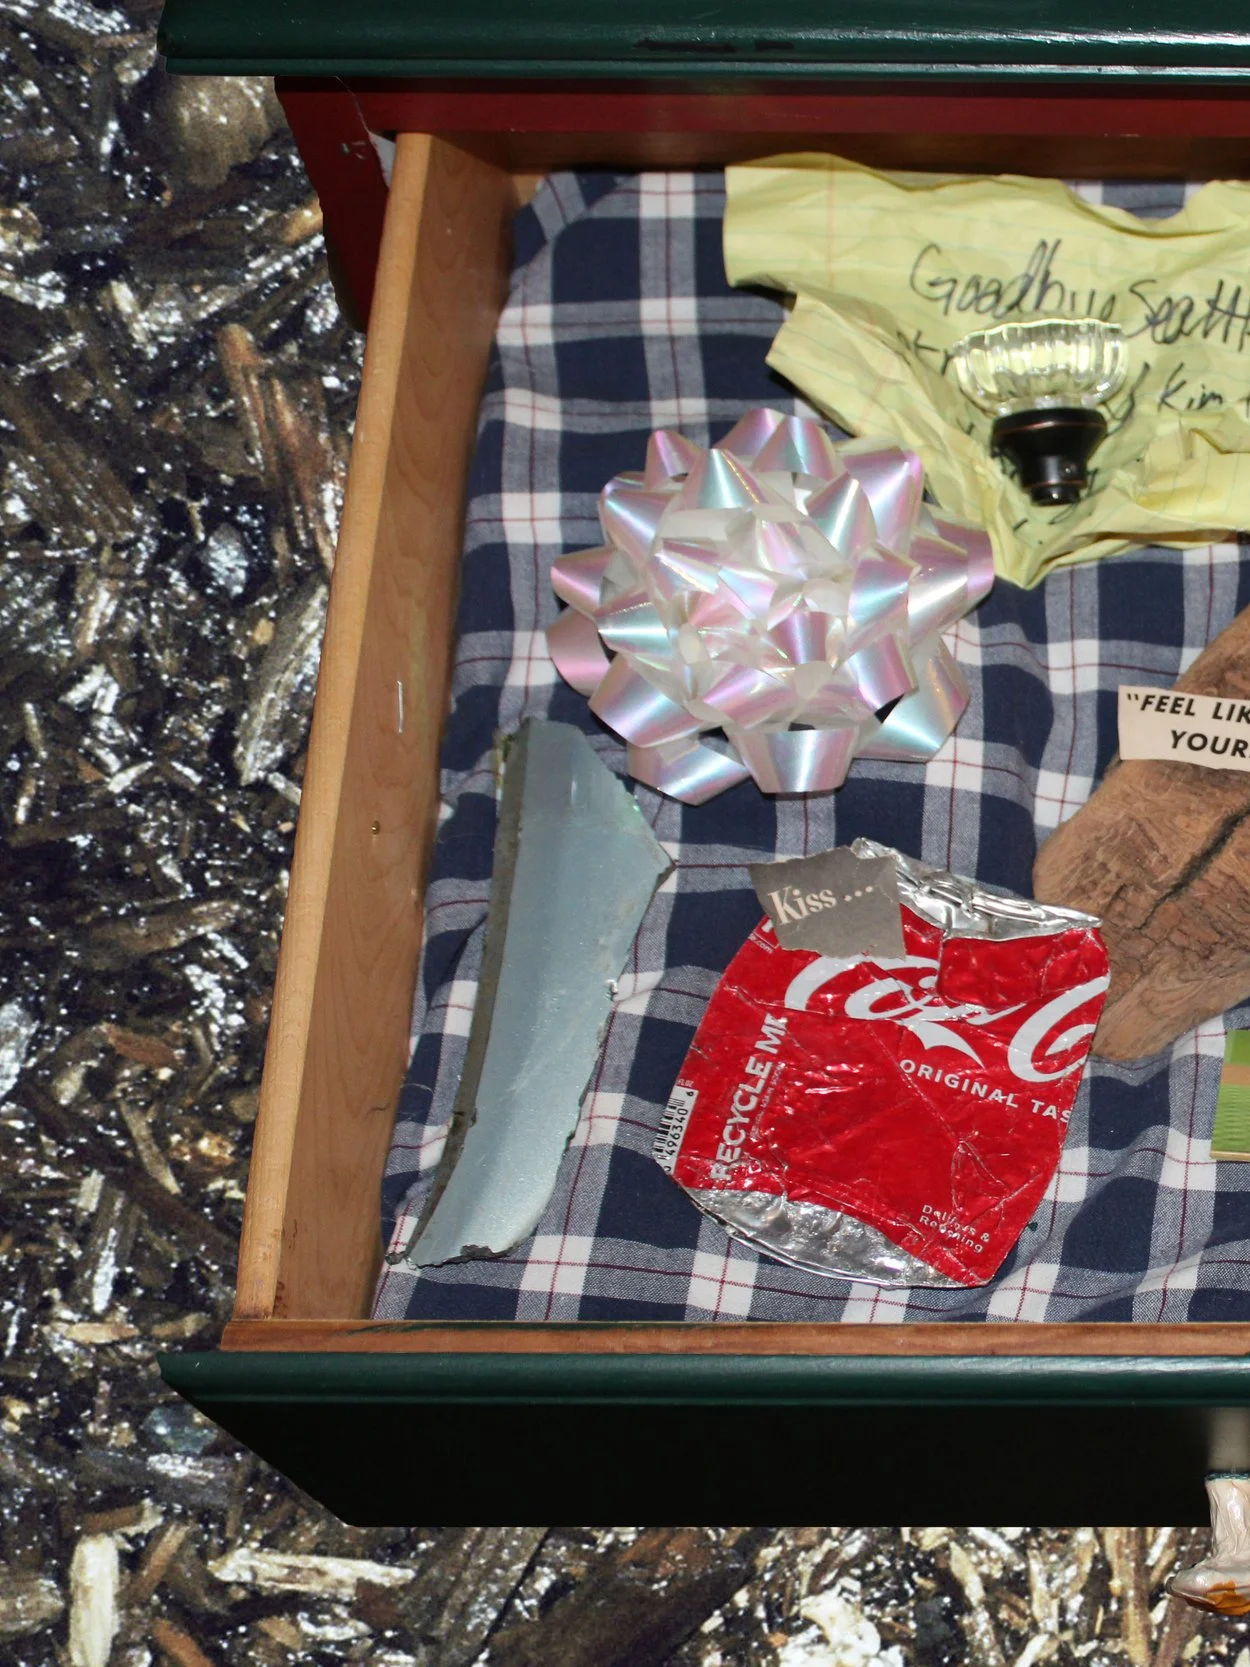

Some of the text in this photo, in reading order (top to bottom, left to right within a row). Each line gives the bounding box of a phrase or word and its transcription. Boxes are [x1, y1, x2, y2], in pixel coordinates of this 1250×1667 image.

[1157, 361, 1223, 413] Kim
[1127, 693, 1196, 717] "FEEL
[900, 1059, 1018, 1107] ORIGINAL
[666, 1107, 689, 1157] 496340
[710, 1056, 772, 1181] RECYCLE
[980, 1232, 990, 1243] &
